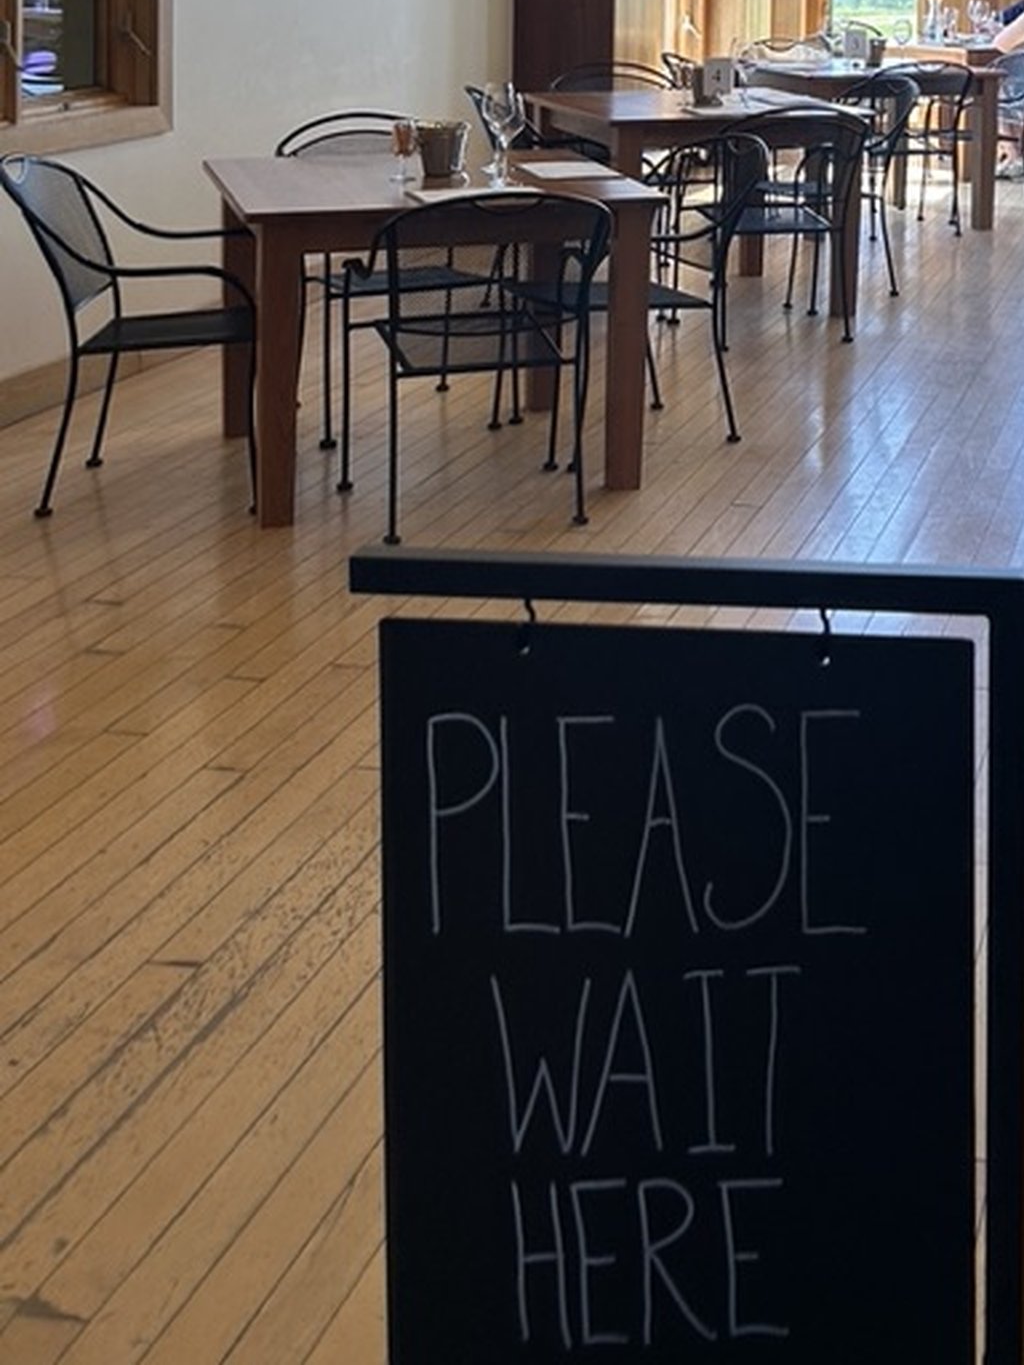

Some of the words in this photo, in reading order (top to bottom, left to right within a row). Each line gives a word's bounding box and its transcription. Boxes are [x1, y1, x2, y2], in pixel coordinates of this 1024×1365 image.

[426, 704, 867, 937] PLEASE
[490, 966, 801, 1156] WAIT
[511, 1179, 790, 1349] HERE
